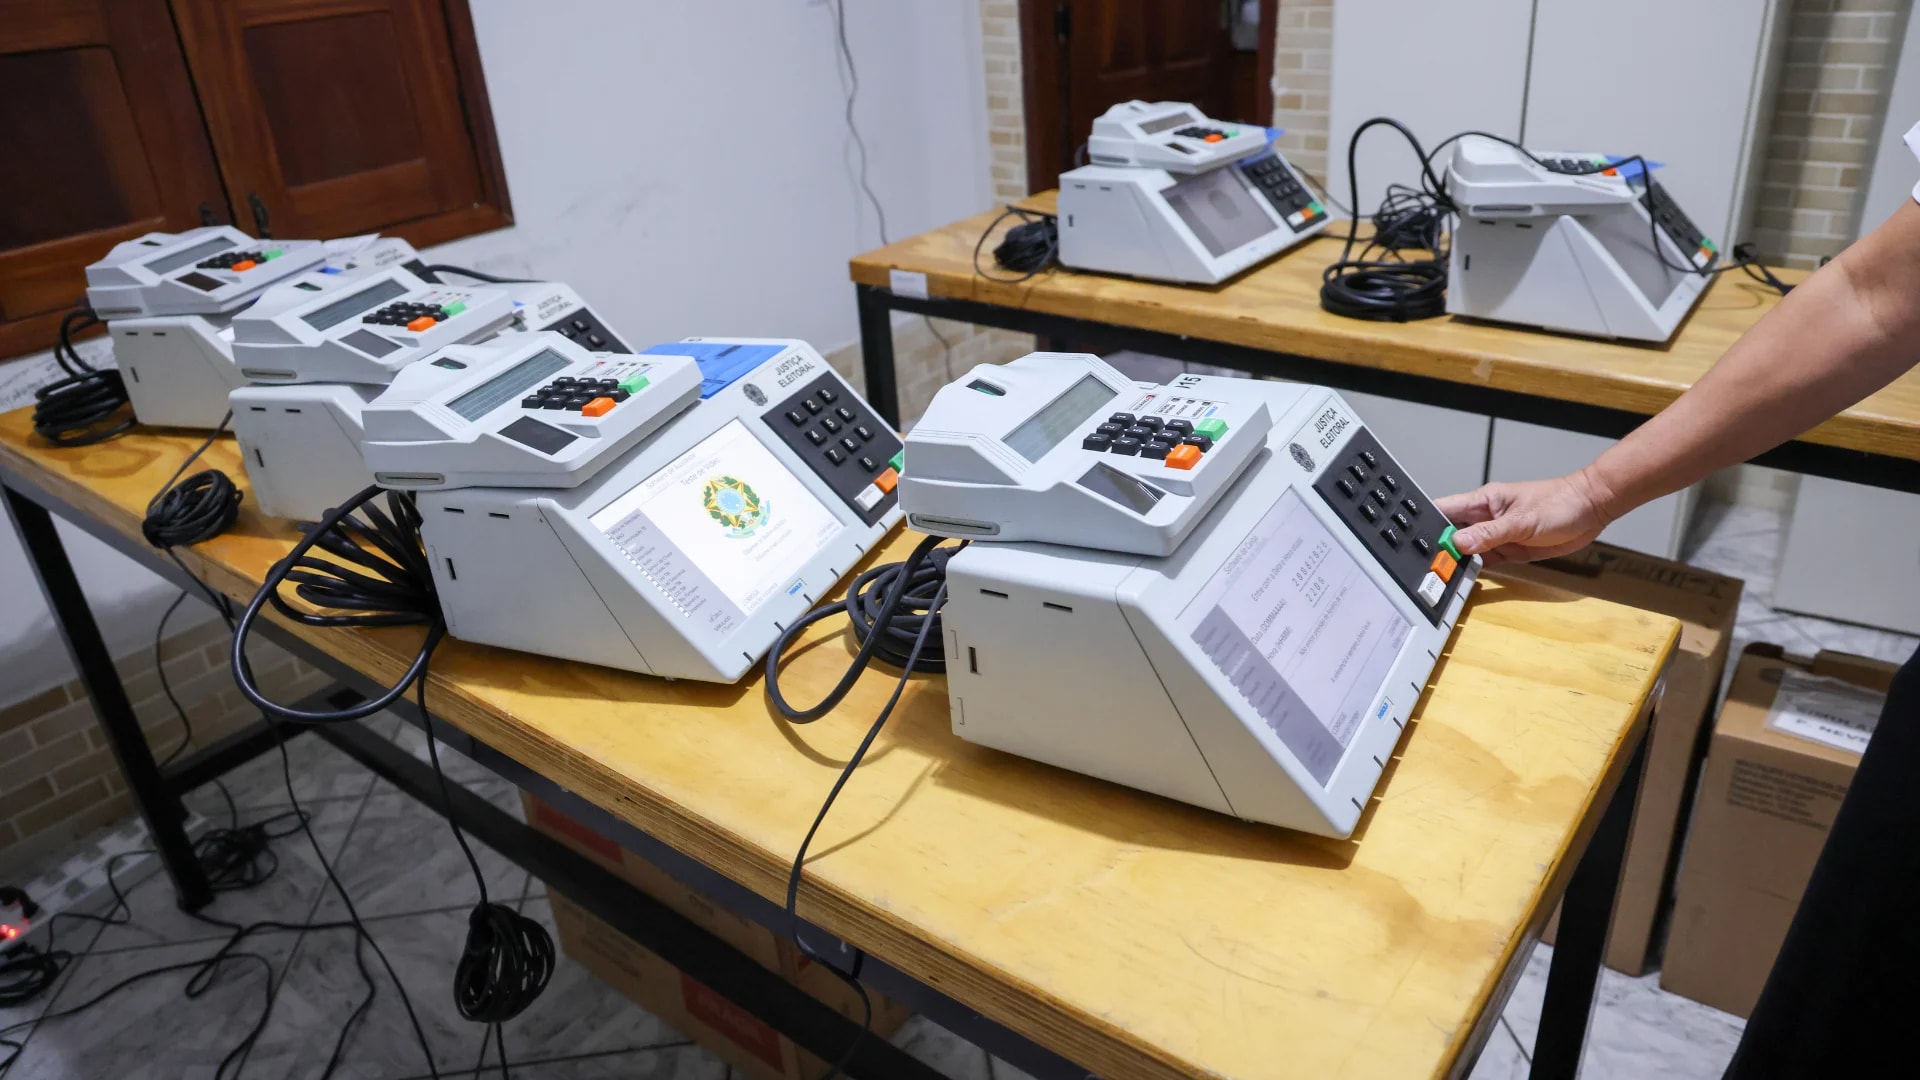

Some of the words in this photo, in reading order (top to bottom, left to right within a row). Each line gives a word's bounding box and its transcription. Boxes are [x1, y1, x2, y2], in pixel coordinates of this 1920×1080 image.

[776, 355, 803, 375] JUSTIÇA
[778, 362, 815, 388] ELEITORAL
[1315, 408, 1338, 433] JUSTIÇA
[1320, 417, 1350, 449] ELEITORAL
